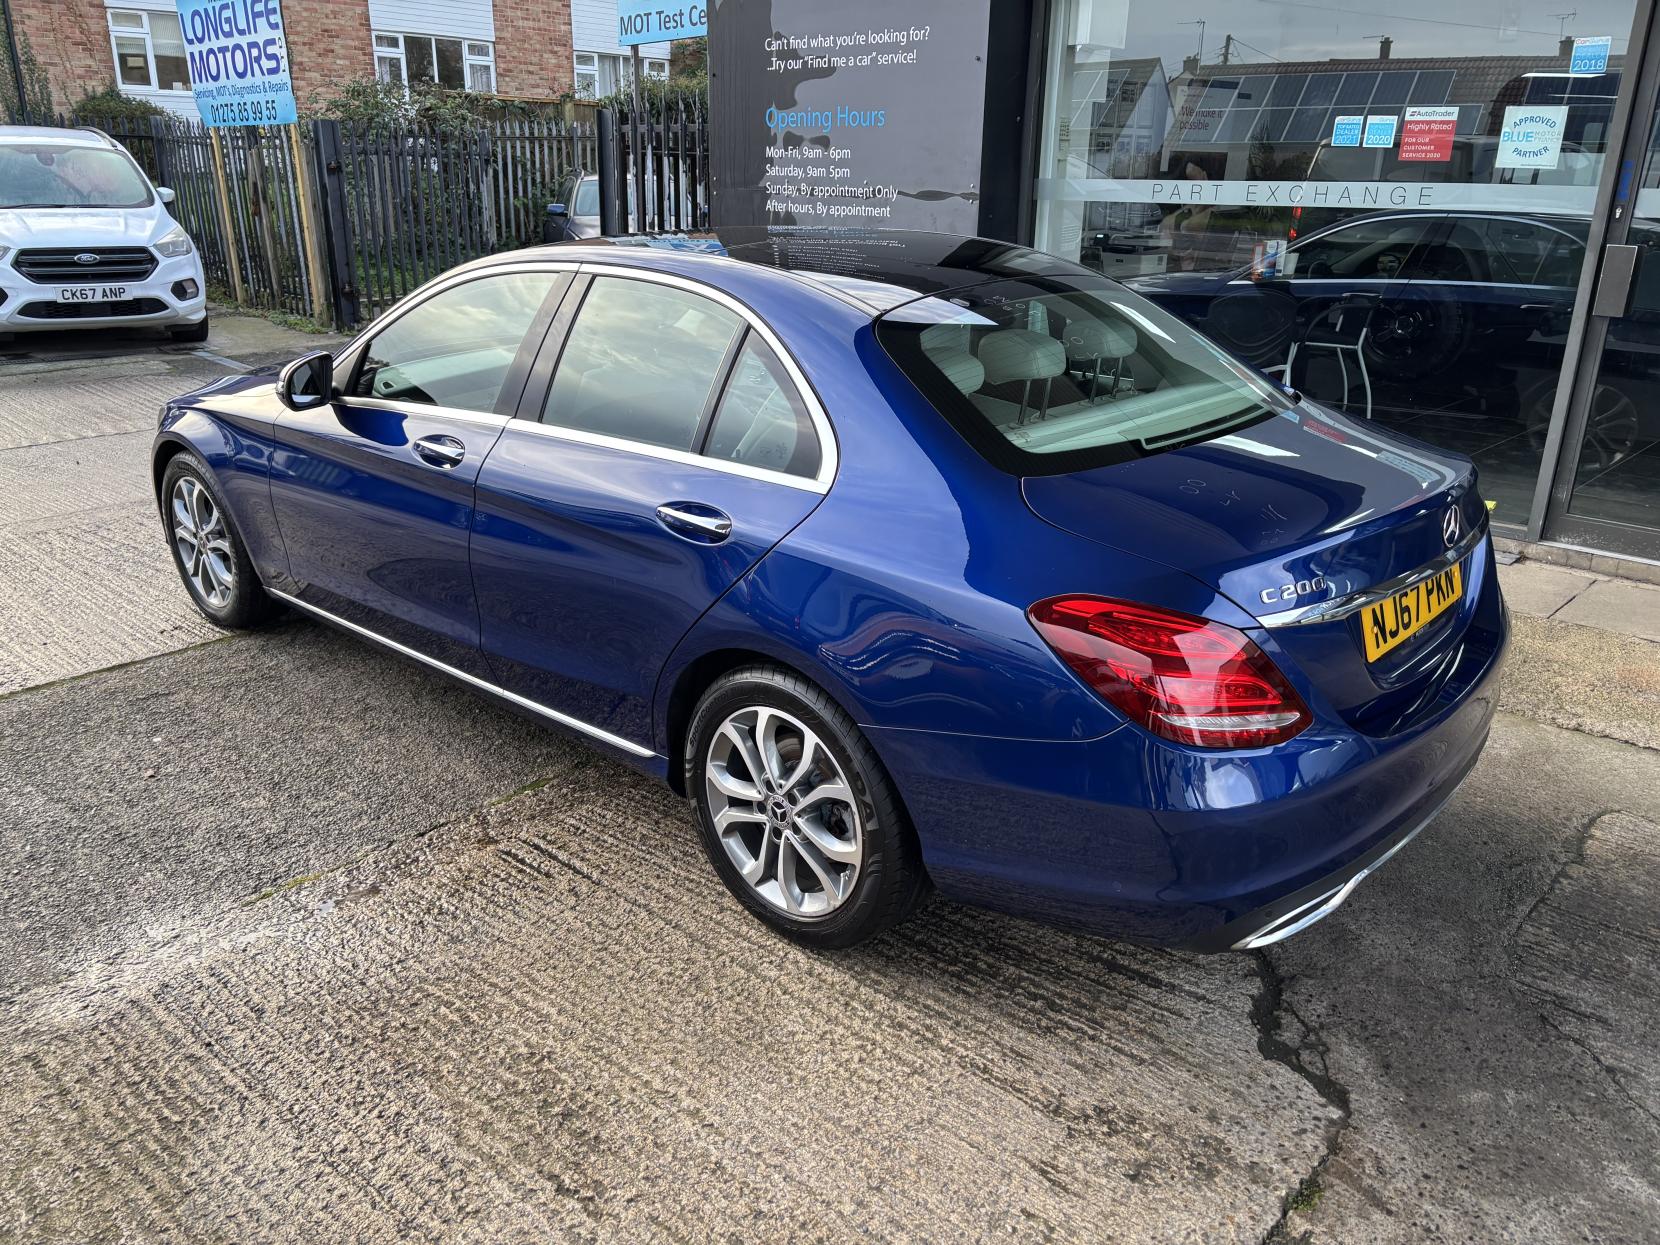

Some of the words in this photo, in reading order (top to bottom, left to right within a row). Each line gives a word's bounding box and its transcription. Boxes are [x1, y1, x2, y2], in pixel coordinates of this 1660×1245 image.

[180, 0, 279, 45] LONGLIFE
[620, 12, 652, 36] MOT
[656, 9, 685, 31] Test
[764, 37, 788, 51] Can't
[790, 35, 808, 49] find
[810, 34, 834, 48] what
[836, 32, 866, 50] you're
[868, 29, 907, 45] looking
[909, 26, 930, 41] for?
[189, 38, 281, 84] MOTORS
[787, 59, 803, 69] our
[831, 57, 846, 67] me
[849, 57, 854, 66] a
[878, 49, 917, 65] service!
[1573, 59, 1604, 71] 2018
[232, 82, 261, 98] Diagnostics
[262, 81, 269, 93] &
[268, 79, 289, 96] Repairs
[211, 103, 236, 123] 01275
[237, 101, 250, 122] 85
[251, 100, 263, 121] 99
[265, 99, 277, 120] 55
[765, 107, 832, 133] Opening
[837, 106, 886, 128] Hours
[1407, 123, 1429, 131] Highly
[1513, 115, 1557, 129] APPROVED
[1335, 135, 1357, 144] 2021
[1368, 135, 1390, 144] 2020
[1502, 131, 1534, 142] BLUE
[765, 146, 801, 159] Mon-Fri,
[803, 147, 822, 159] 9am
[829, 147, 851, 161] 6pm
[1512, 146, 1550, 158] PARTNER
[765, 164, 805, 179] Saturday,
[807, 166, 826, 177] 9am
[829, 166, 850, 180] 5pm
[765, 182, 799, 197] Sunday,
[801, 183, 811, 197] By
[813, 184, 873, 199] appointment
[875, 185, 898, 201] Only
[1151, 183, 1223, 202] PART
[1246, 185, 1434, 206] EXCHANGE
[765, 200, 786, 212] After
[788, 200, 815, 215] hours,
[817, 202, 828, 216] By
[829, 203, 891, 217] appointment
[61, 288, 97, 301] CK67
[101, 287, 126, 299] ANP
[1260, 588, 1278, 604] C
[1280, 576, 1327, 600] 200
[1372, 585, 1420, 649] NJ67
[1425, 568, 1455, 613] PKN
